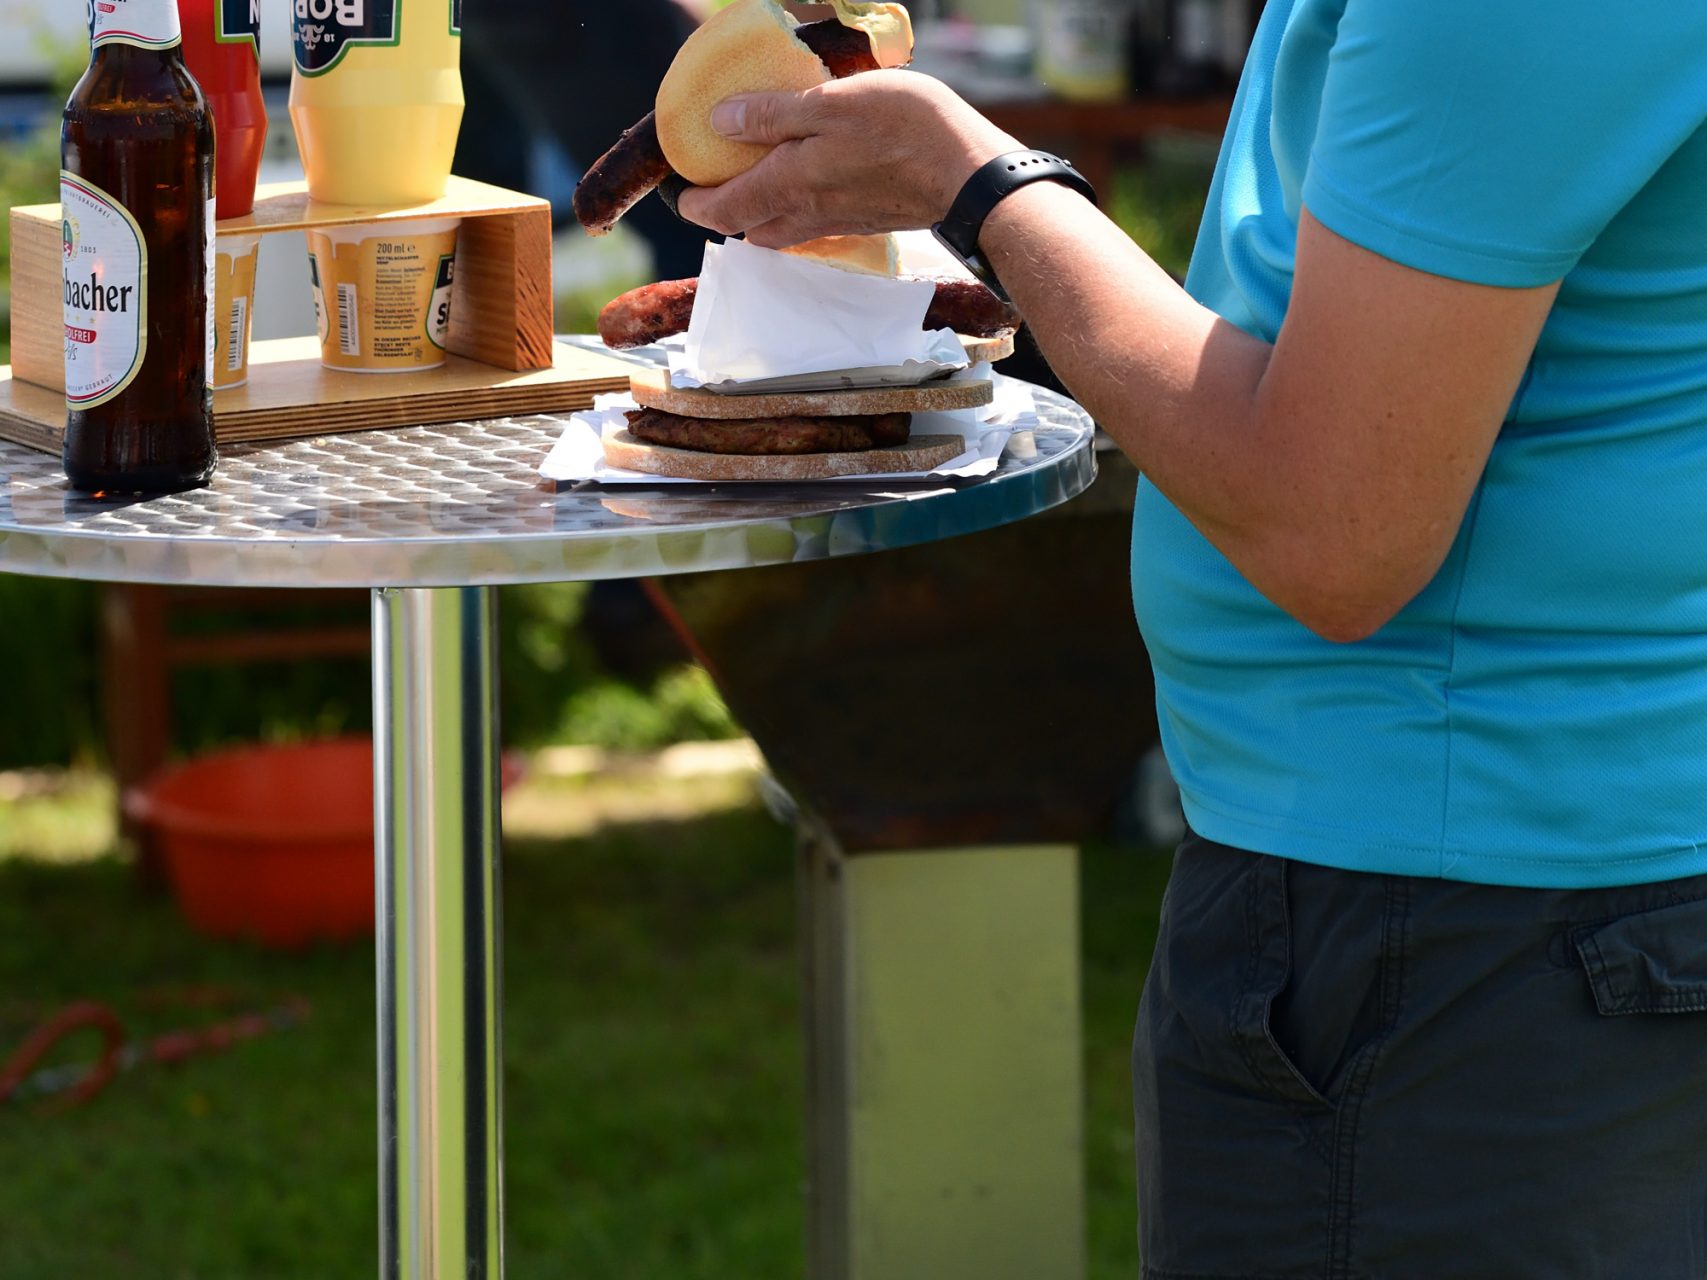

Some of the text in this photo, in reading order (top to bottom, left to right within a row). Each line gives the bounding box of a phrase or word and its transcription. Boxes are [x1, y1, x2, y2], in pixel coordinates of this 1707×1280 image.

[377, 243, 393, 254] 200
[394, 243, 405, 253] ml
[63, 267, 133, 313] bacher
